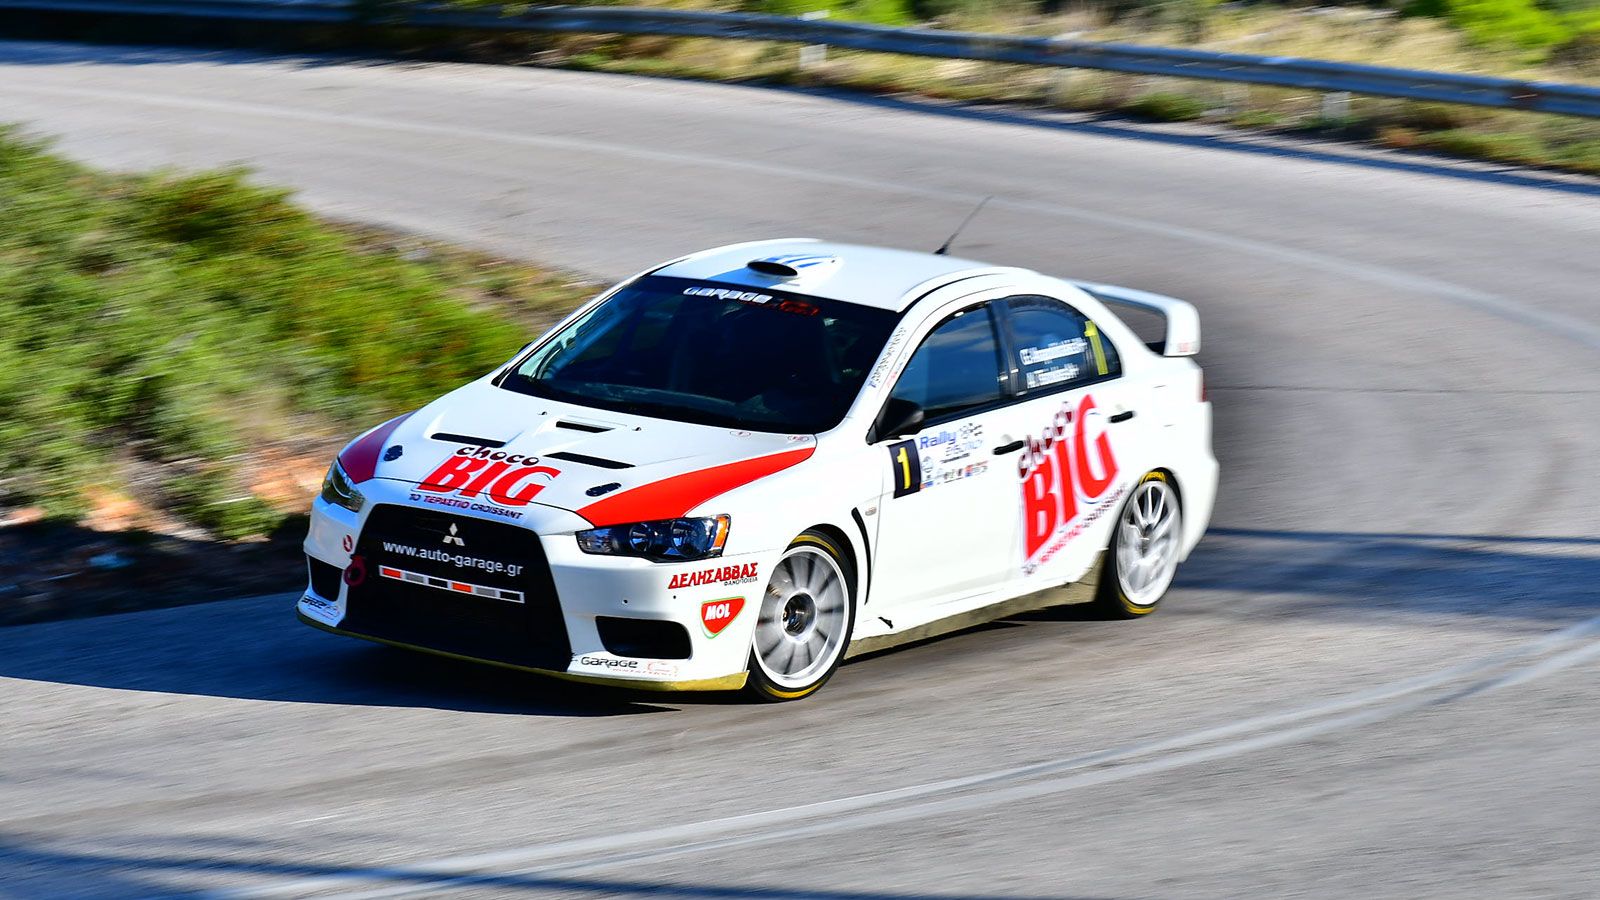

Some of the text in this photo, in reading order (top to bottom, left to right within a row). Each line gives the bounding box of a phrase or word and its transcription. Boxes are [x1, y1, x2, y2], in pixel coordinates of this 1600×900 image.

[920, 430, 957, 450] Rally
[456, 446, 539, 466] choco
[897, 447, 911, 489] 1
[417, 456, 562, 506] BIG
[1024, 393, 1118, 560] BIG
[470, 503, 523, 519] CROISSANT
[383, 541, 523, 576] www.auto-garage.gr
[668, 562, 758, 590] ΔΕΛΗΣΑΒΒΑΣ
[704, 603, 731, 621] MOL
